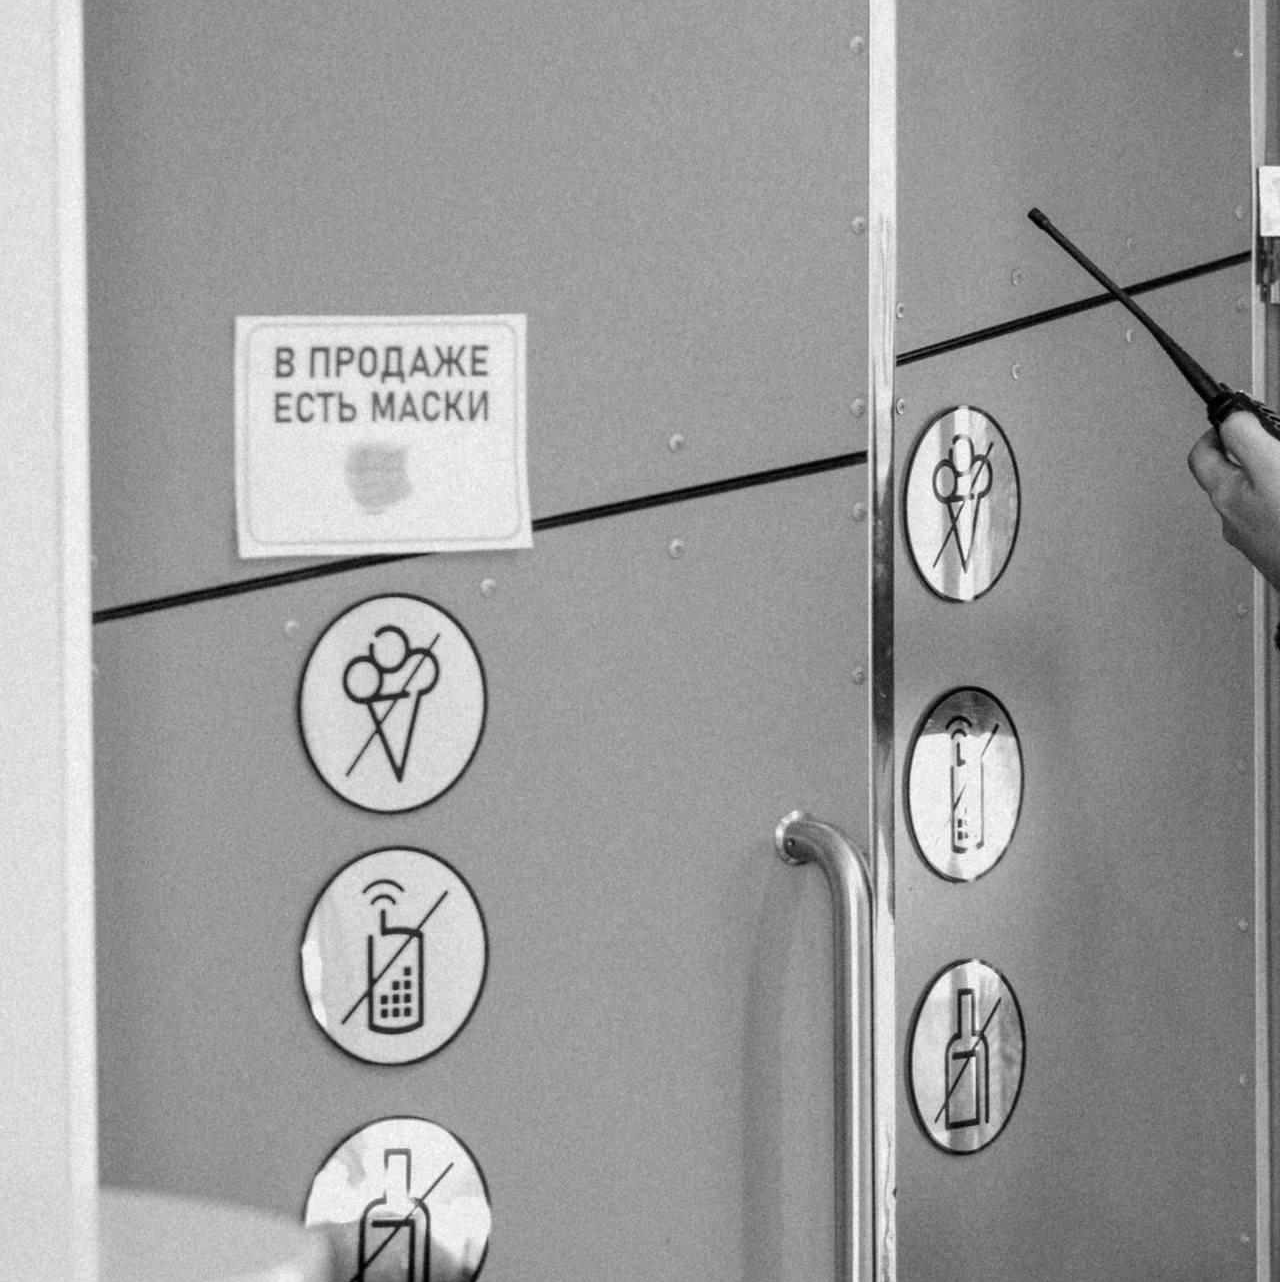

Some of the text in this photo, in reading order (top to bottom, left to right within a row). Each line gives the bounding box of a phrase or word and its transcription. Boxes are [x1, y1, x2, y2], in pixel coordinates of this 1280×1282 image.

[275, 345, 489, 384] В ПРОДАЖЕ
[275, 390, 489, 423] ЕСТЬ МАСКИ
